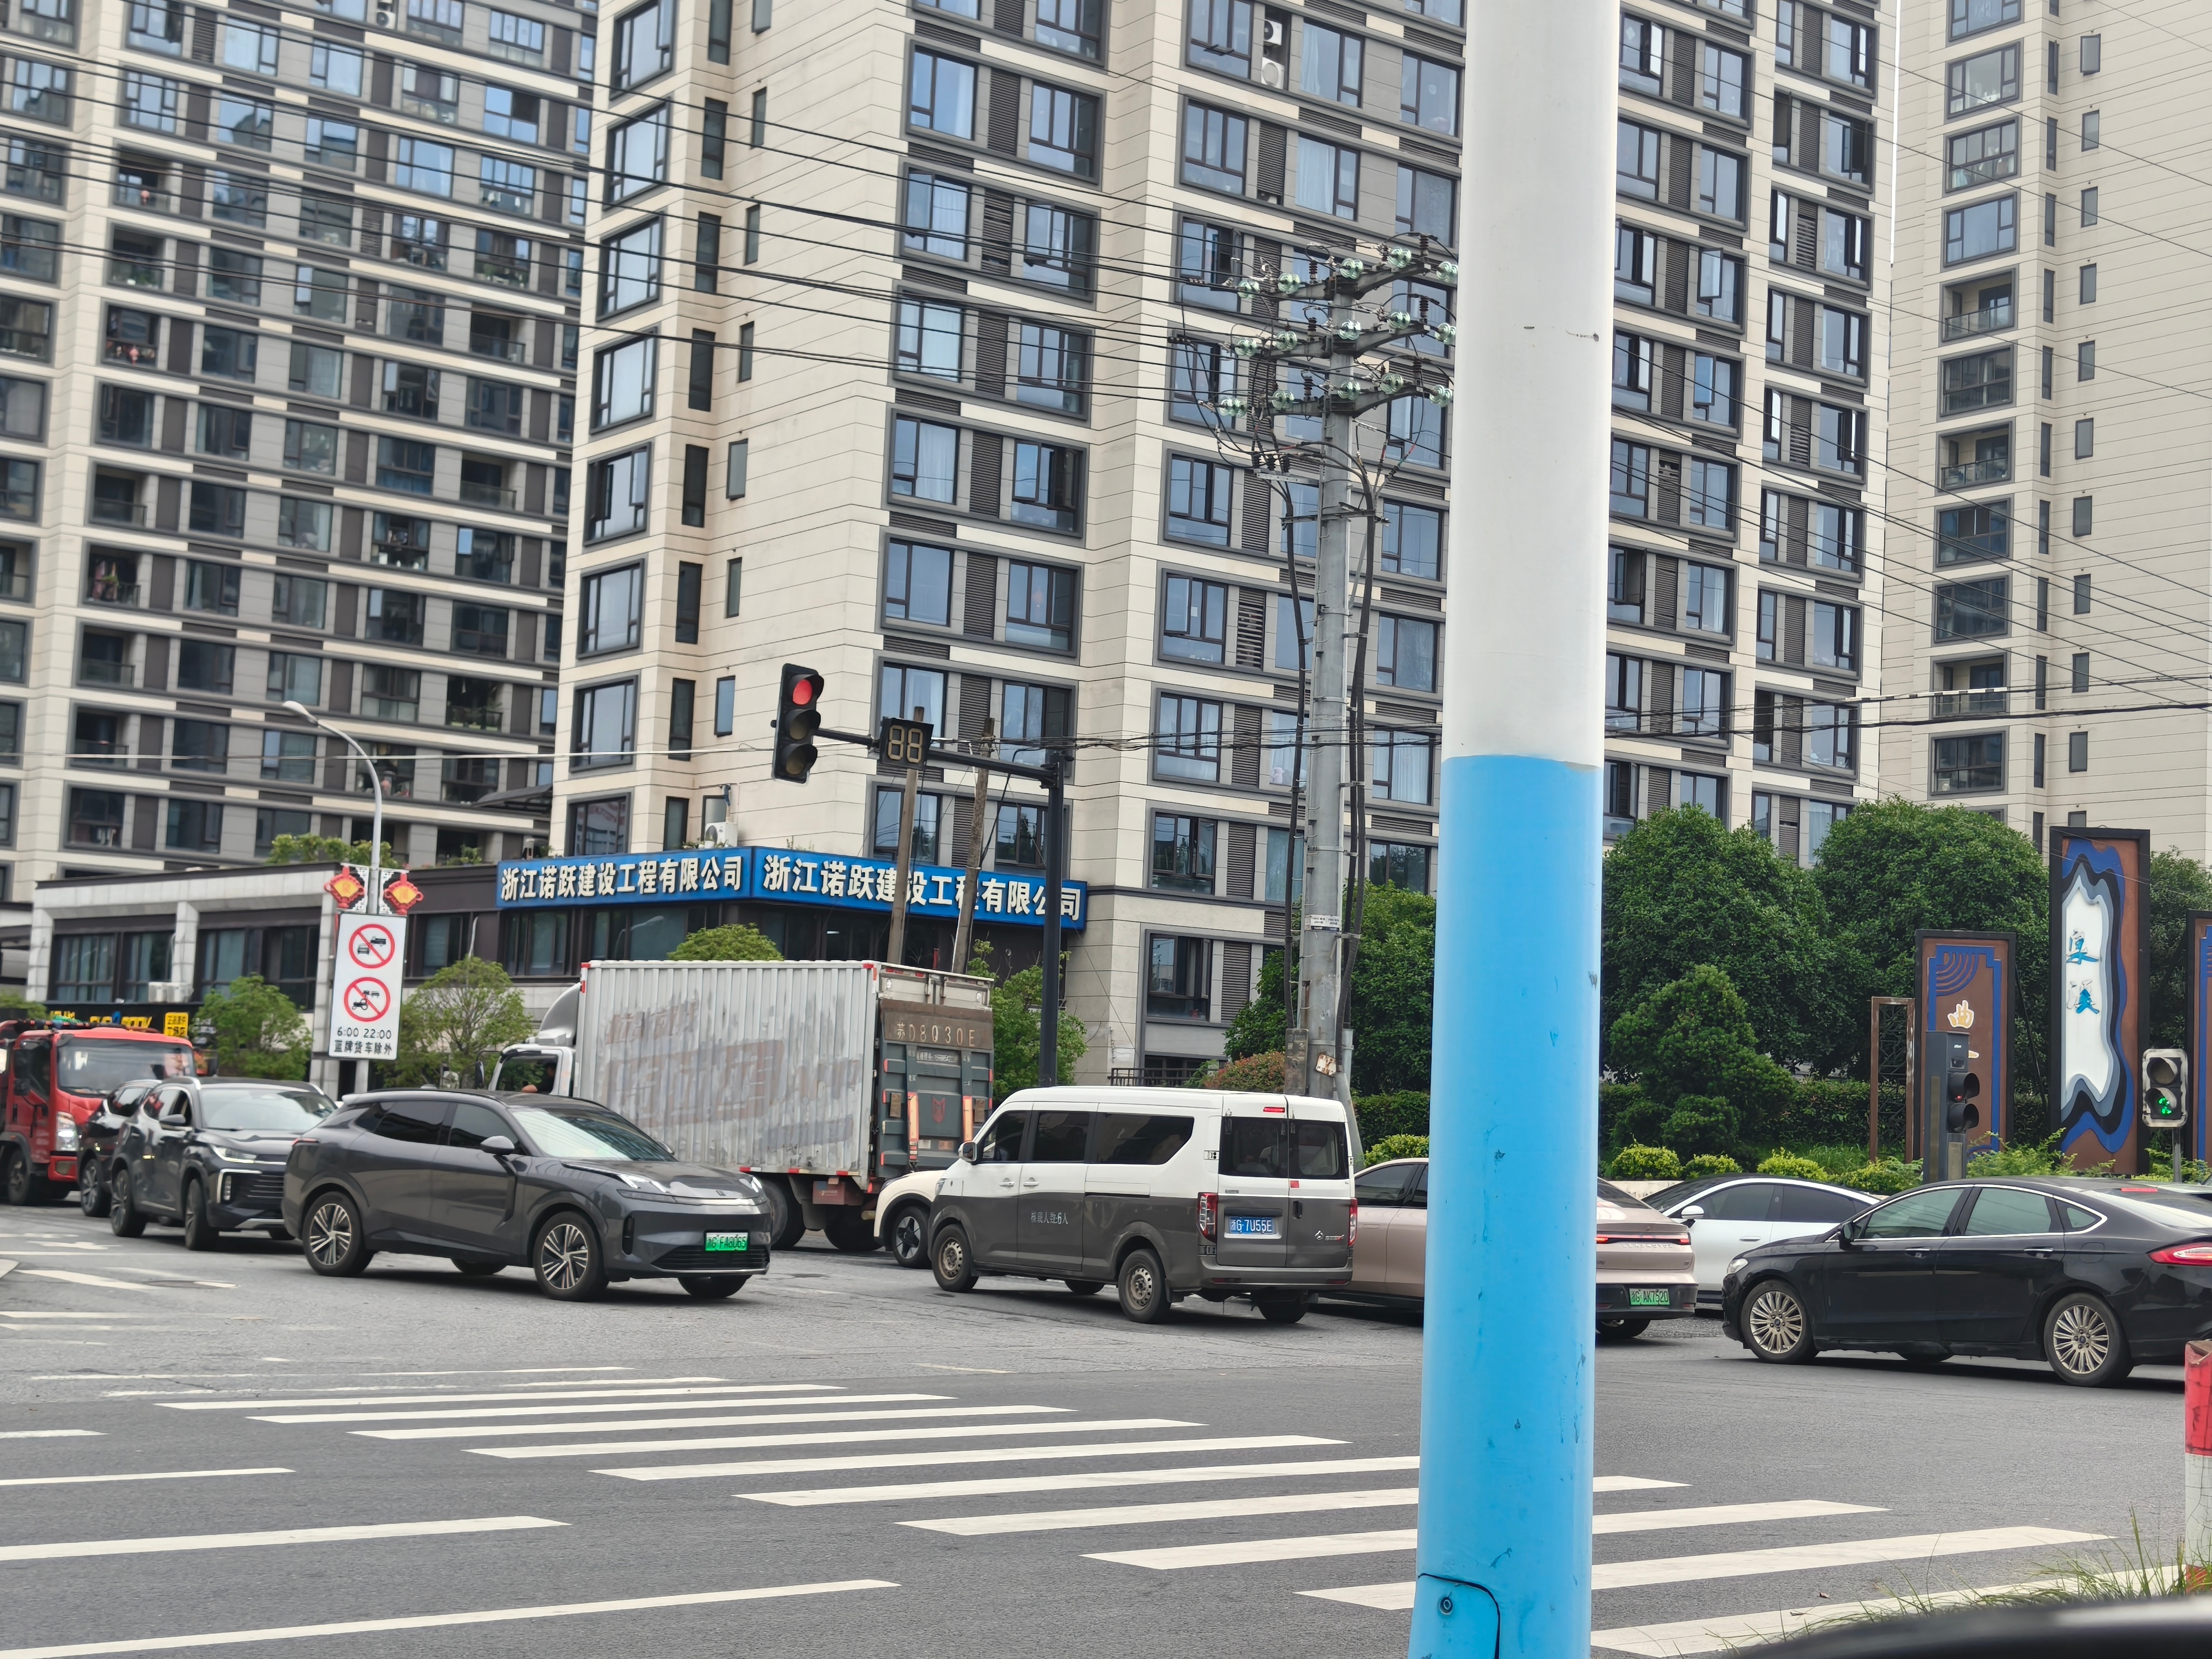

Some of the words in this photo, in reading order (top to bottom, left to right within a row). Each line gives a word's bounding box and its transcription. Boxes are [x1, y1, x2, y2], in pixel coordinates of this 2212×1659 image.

[501, 855, 742, 901] 浙江诺跃建设工程有限公司
[896, 1022, 975, 1047] 苏D8Q30E
